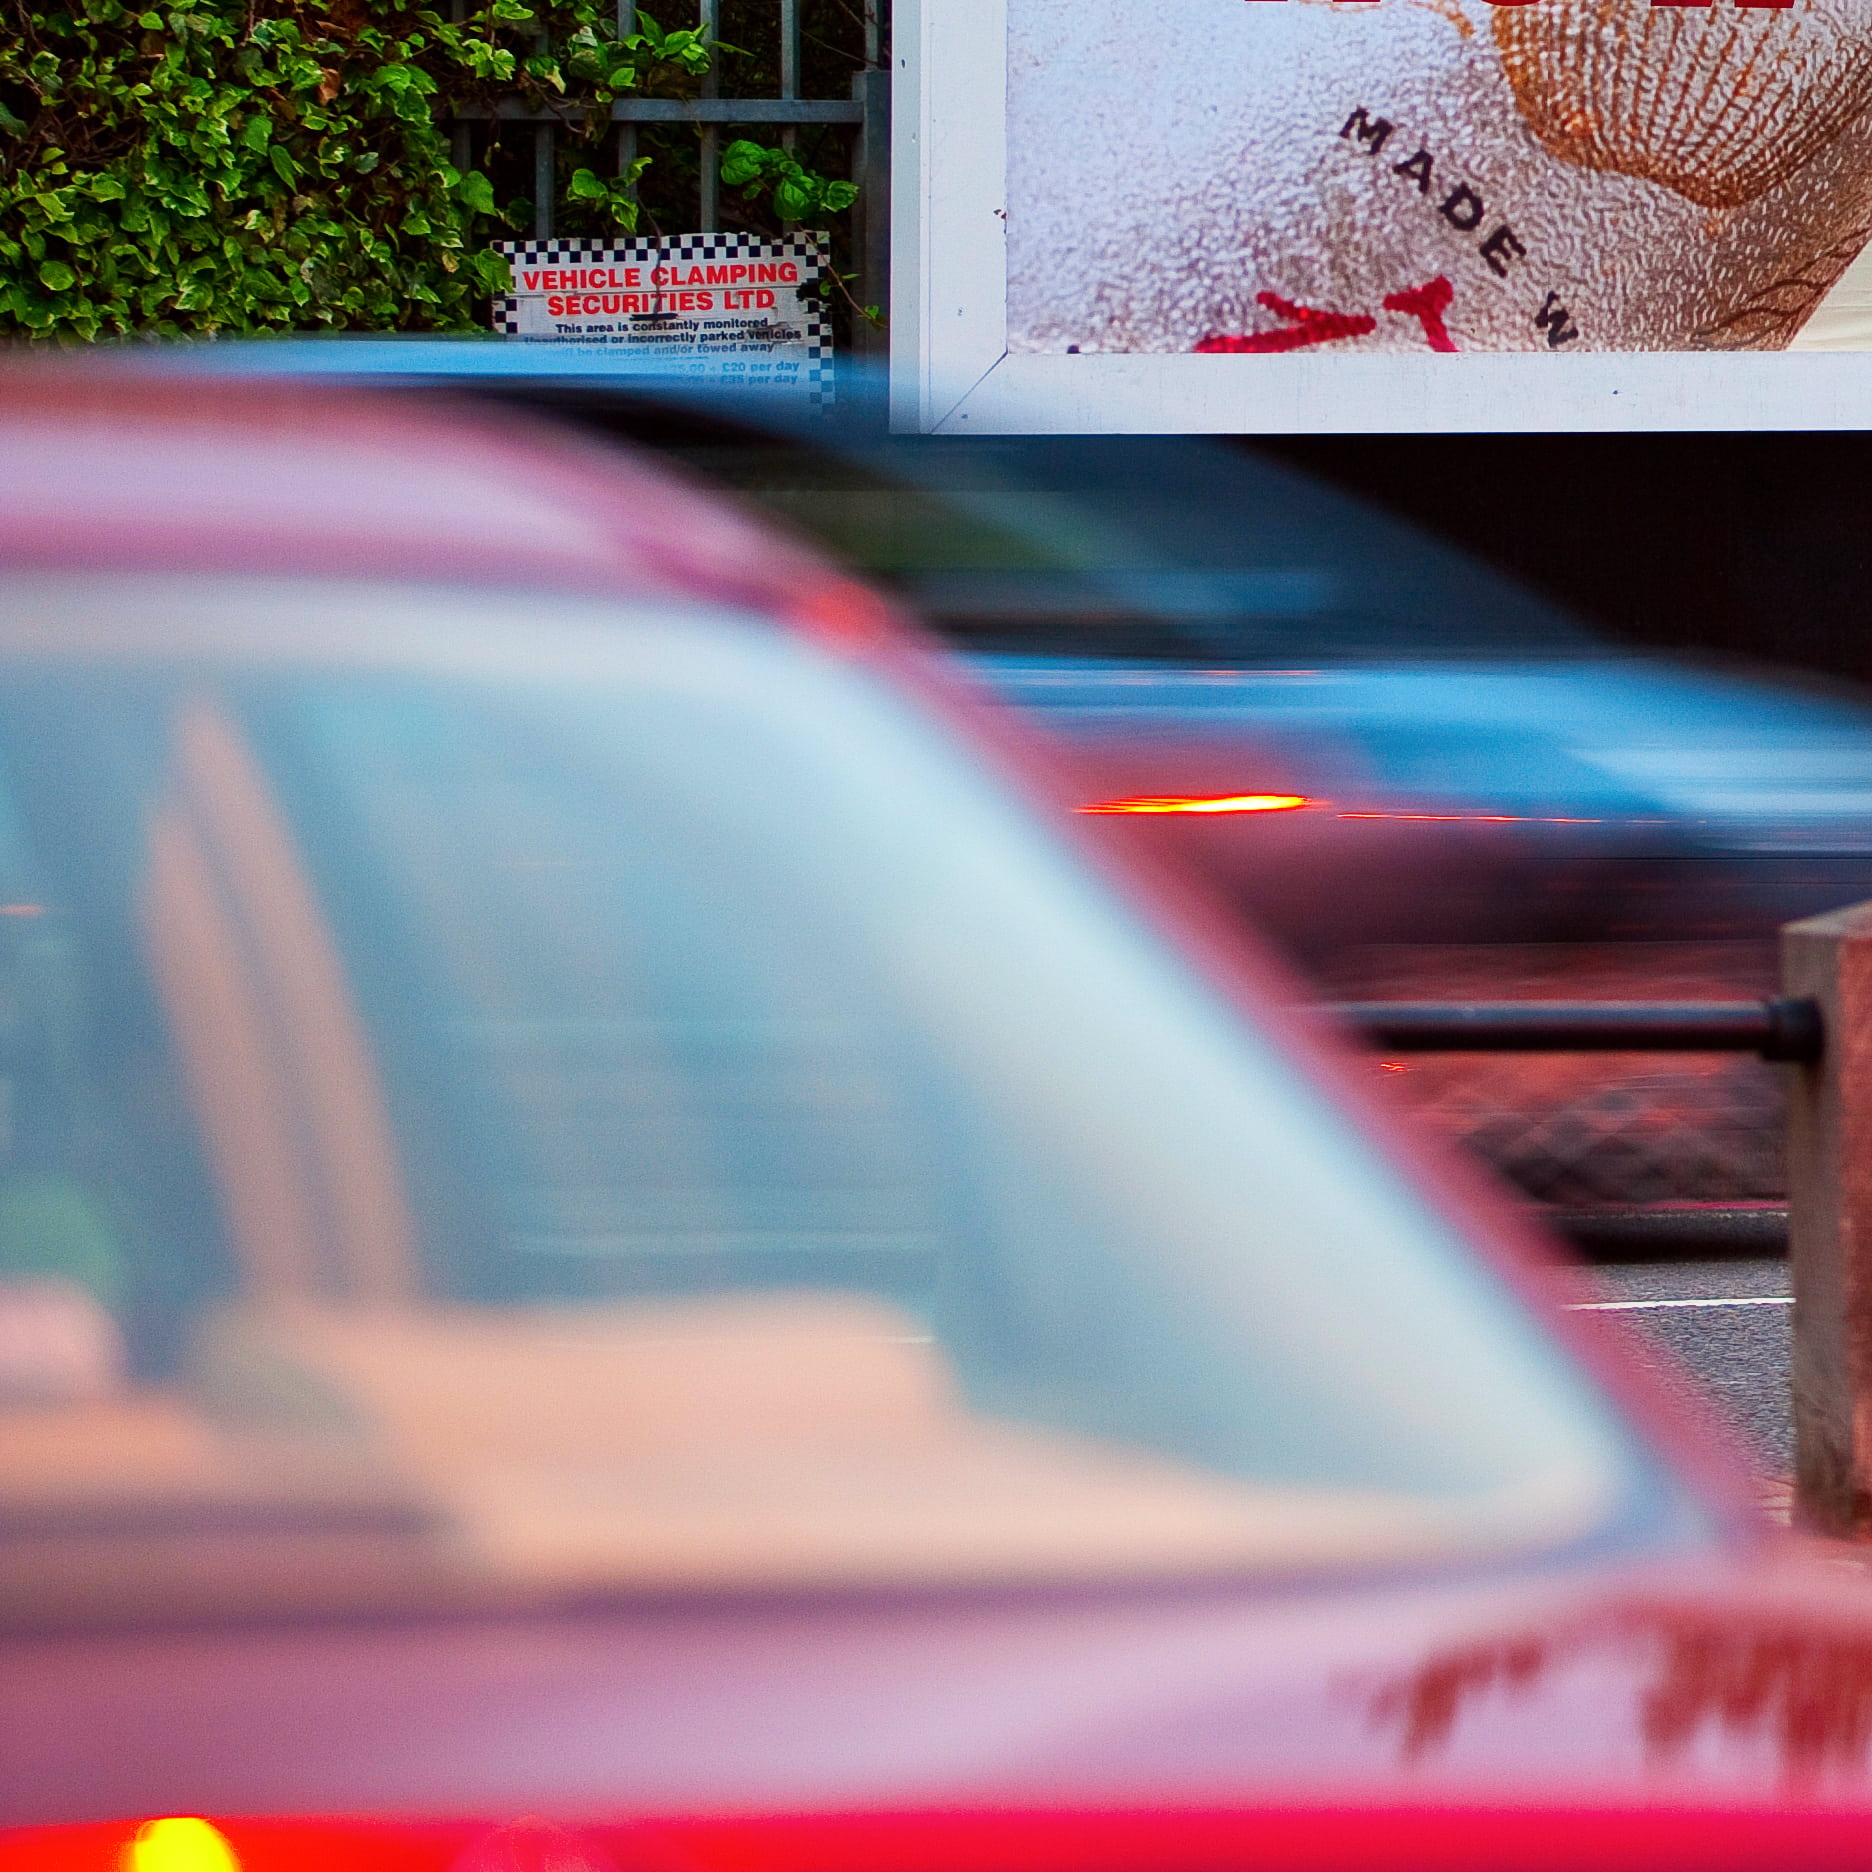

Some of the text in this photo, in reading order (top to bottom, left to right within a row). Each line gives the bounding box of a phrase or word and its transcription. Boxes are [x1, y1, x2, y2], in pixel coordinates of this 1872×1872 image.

[1340, 106, 1527, 278] MADE
[522, 262, 799, 291] VEHICLE CLAMPING
[547, 289, 775, 316] SECURITIES LTD
[555, 317, 769, 334] This area is constantly monitored
[611, 335, 625, 344] or
[627, 331, 697, 344] incorrectly
[700, 330, 745, 343] parked
[654, 342, 693, 355] and/or
[697, 342, 738, 353] towed
[741, 342, 775, 353] away
[750, 362, 773, 373] per
[775, 360, 800, 372] day
